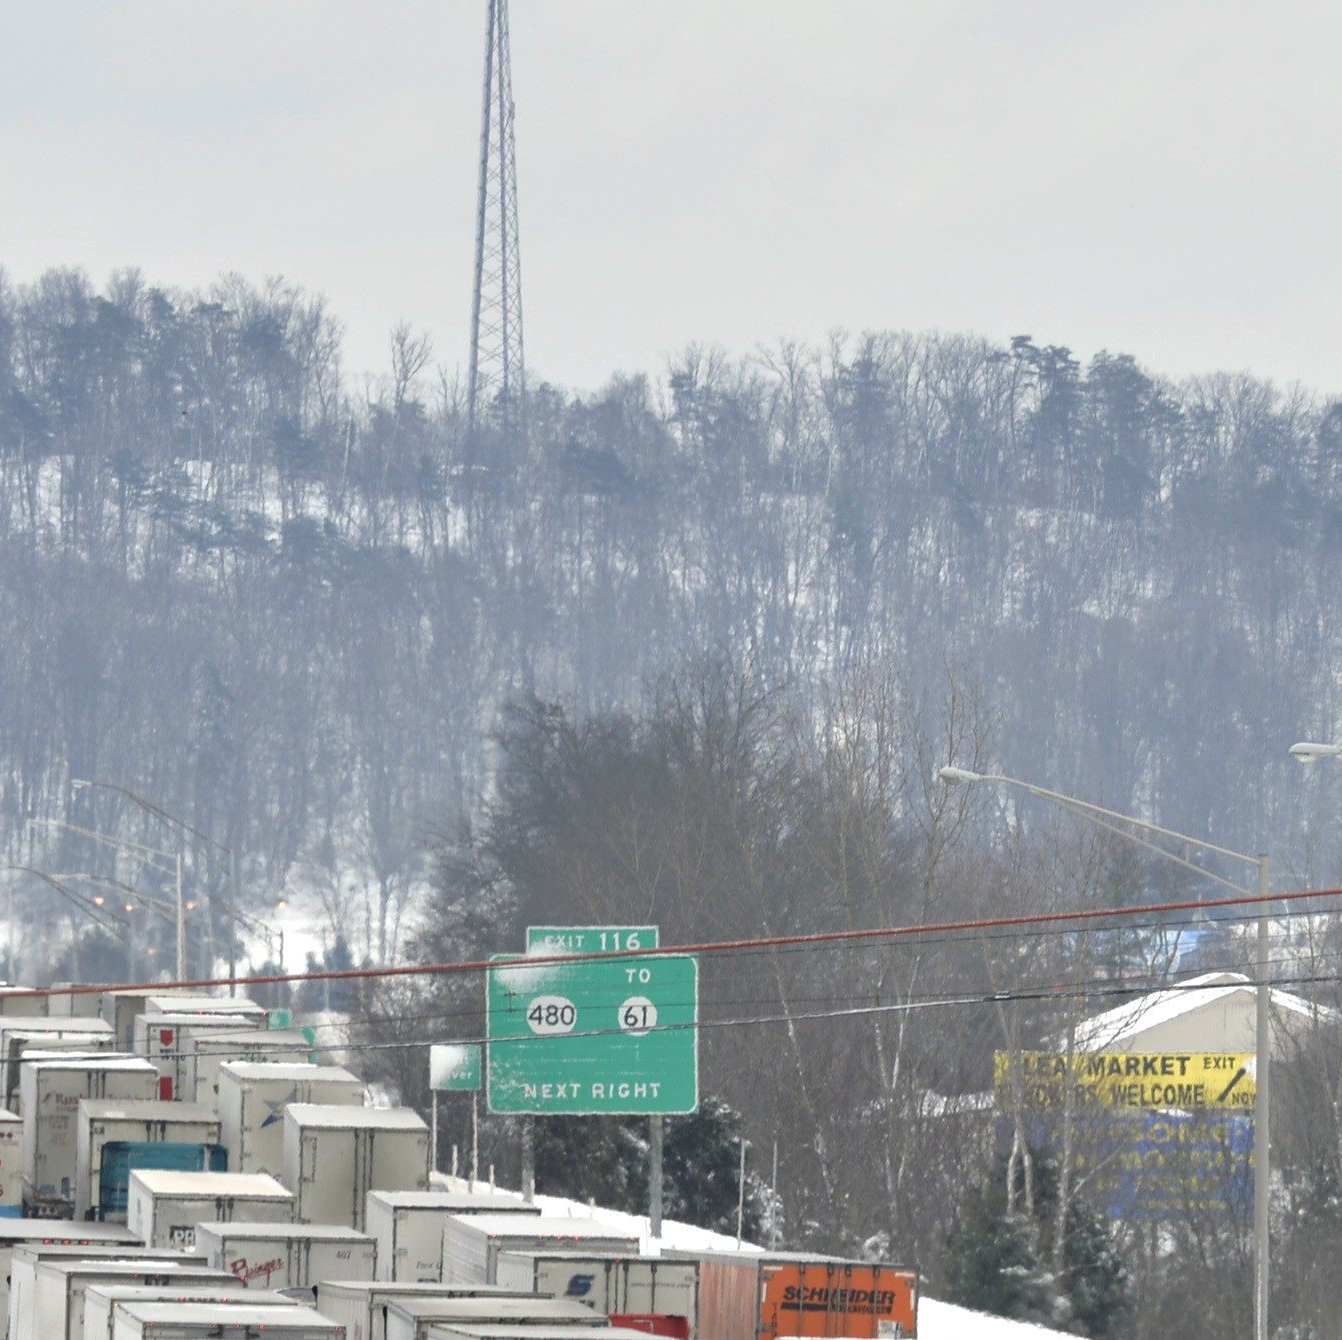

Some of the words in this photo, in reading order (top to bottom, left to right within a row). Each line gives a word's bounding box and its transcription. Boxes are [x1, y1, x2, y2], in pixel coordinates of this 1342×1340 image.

[545, 935, 585, 948] EXIT
[599, 932, 641, 950] 116
[625, 968, 651, 983] TO
[528, 1005, 576, 1027] 480
[623, 1005, 648, 1027] 61
[1019, 1056, 1067, 1076] LEA
[1087, 1056, 1191, 1077] MARKET
[1203, 1056, 1236, 1070] EXIT
[523, 1083, 581, 1098] NEXT
[592, 1083, 661, 1099] RIGHT
[1114, 1083, 1205, 1106] WELCOME
[783, 1286, 896, 1305] SCHNEIDER
